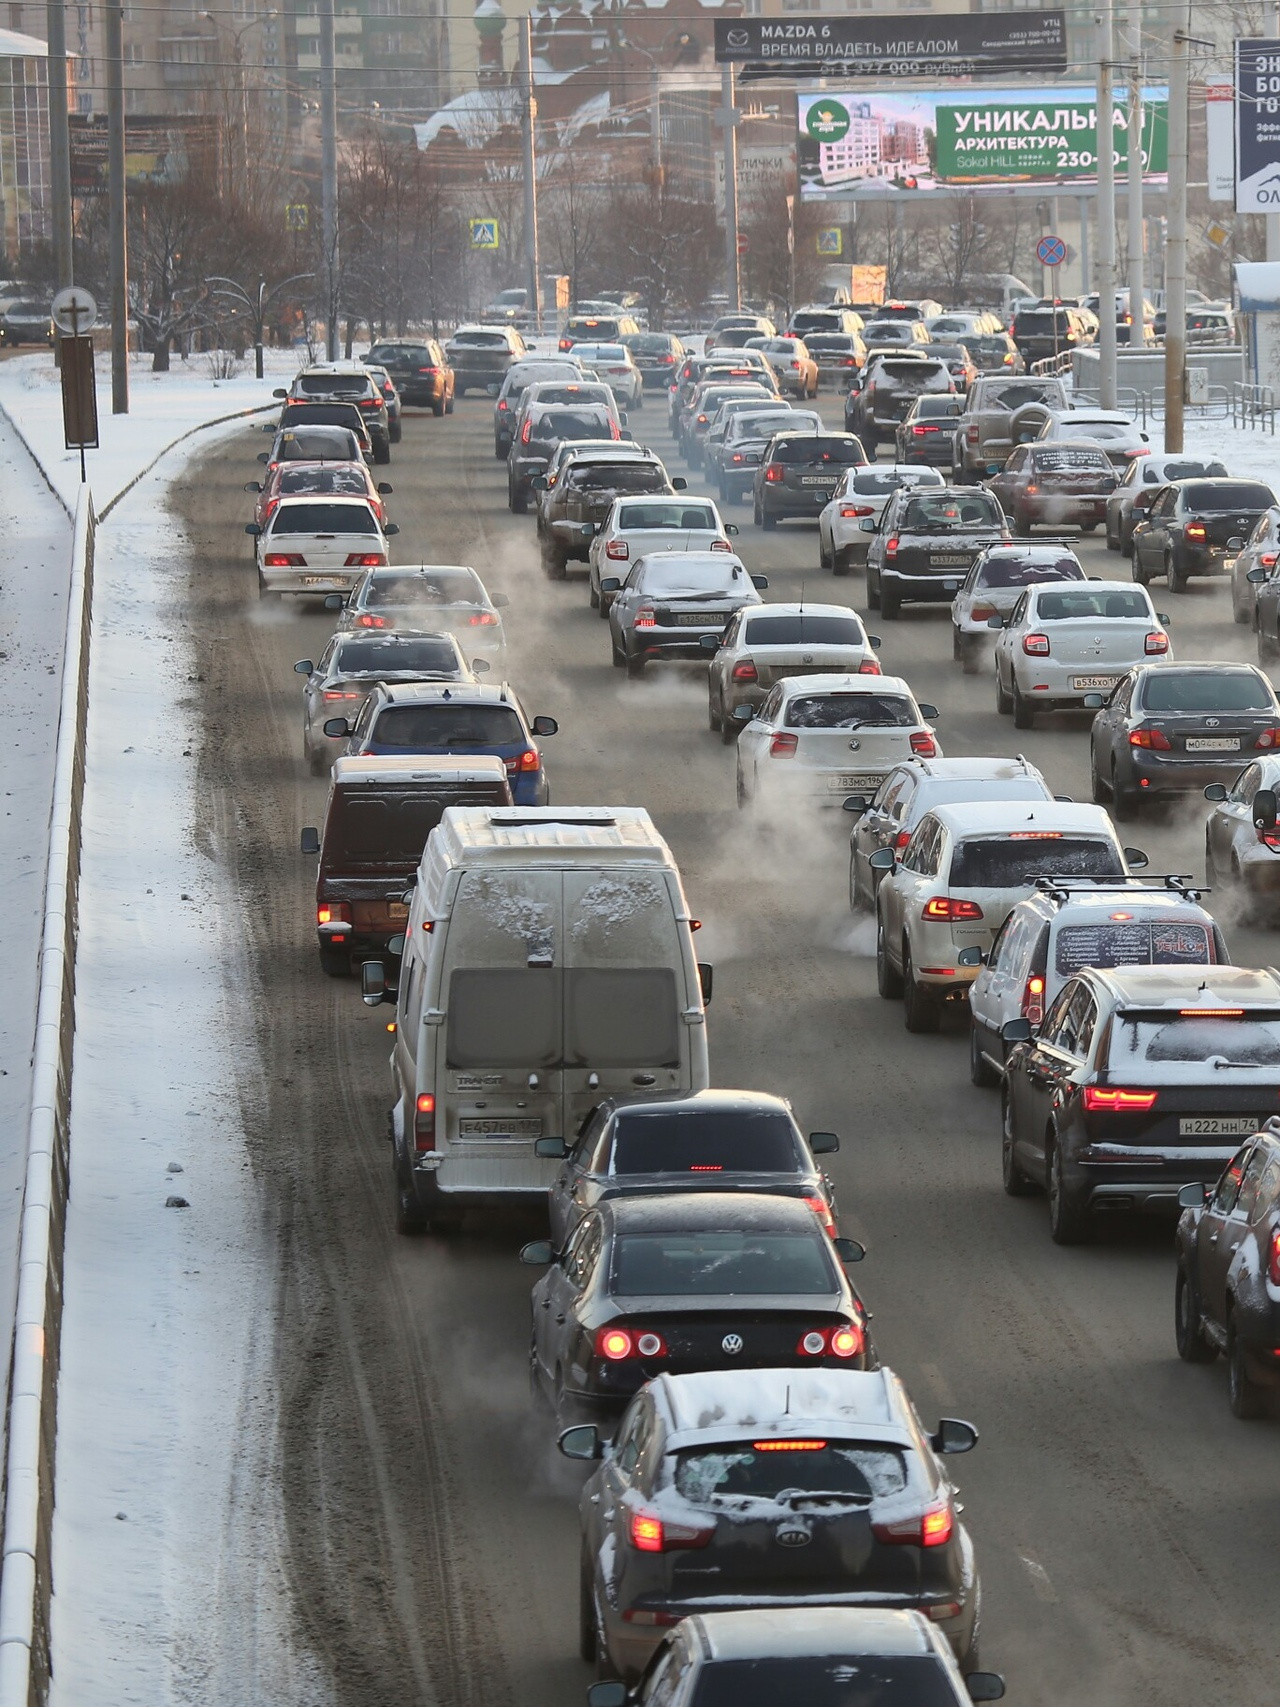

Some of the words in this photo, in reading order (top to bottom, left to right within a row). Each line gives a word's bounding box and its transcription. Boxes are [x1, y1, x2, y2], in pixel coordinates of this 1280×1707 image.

[761, 25, 817, 38] MAZDA
[821, 25, 831, 38] 6
[761, 43, 811, 57] ВРЕМЯ
[815, 42, 882, 57] ВЛАДЕТЬ
[886, 40, 959, 56] ИДЕАЛОМ
[954, 136, 1069, 151] АРХИТЕКТУРА
[719, 157, 783, 170] ТЛИЧКИ
[956, 155, 988, 168] Sokol
[457, 1075, 504, 1086] TRANSIT
[1184, 1120, 1239, 1133] Н222НН
[1241, 1118, 1255, 1129] 74
